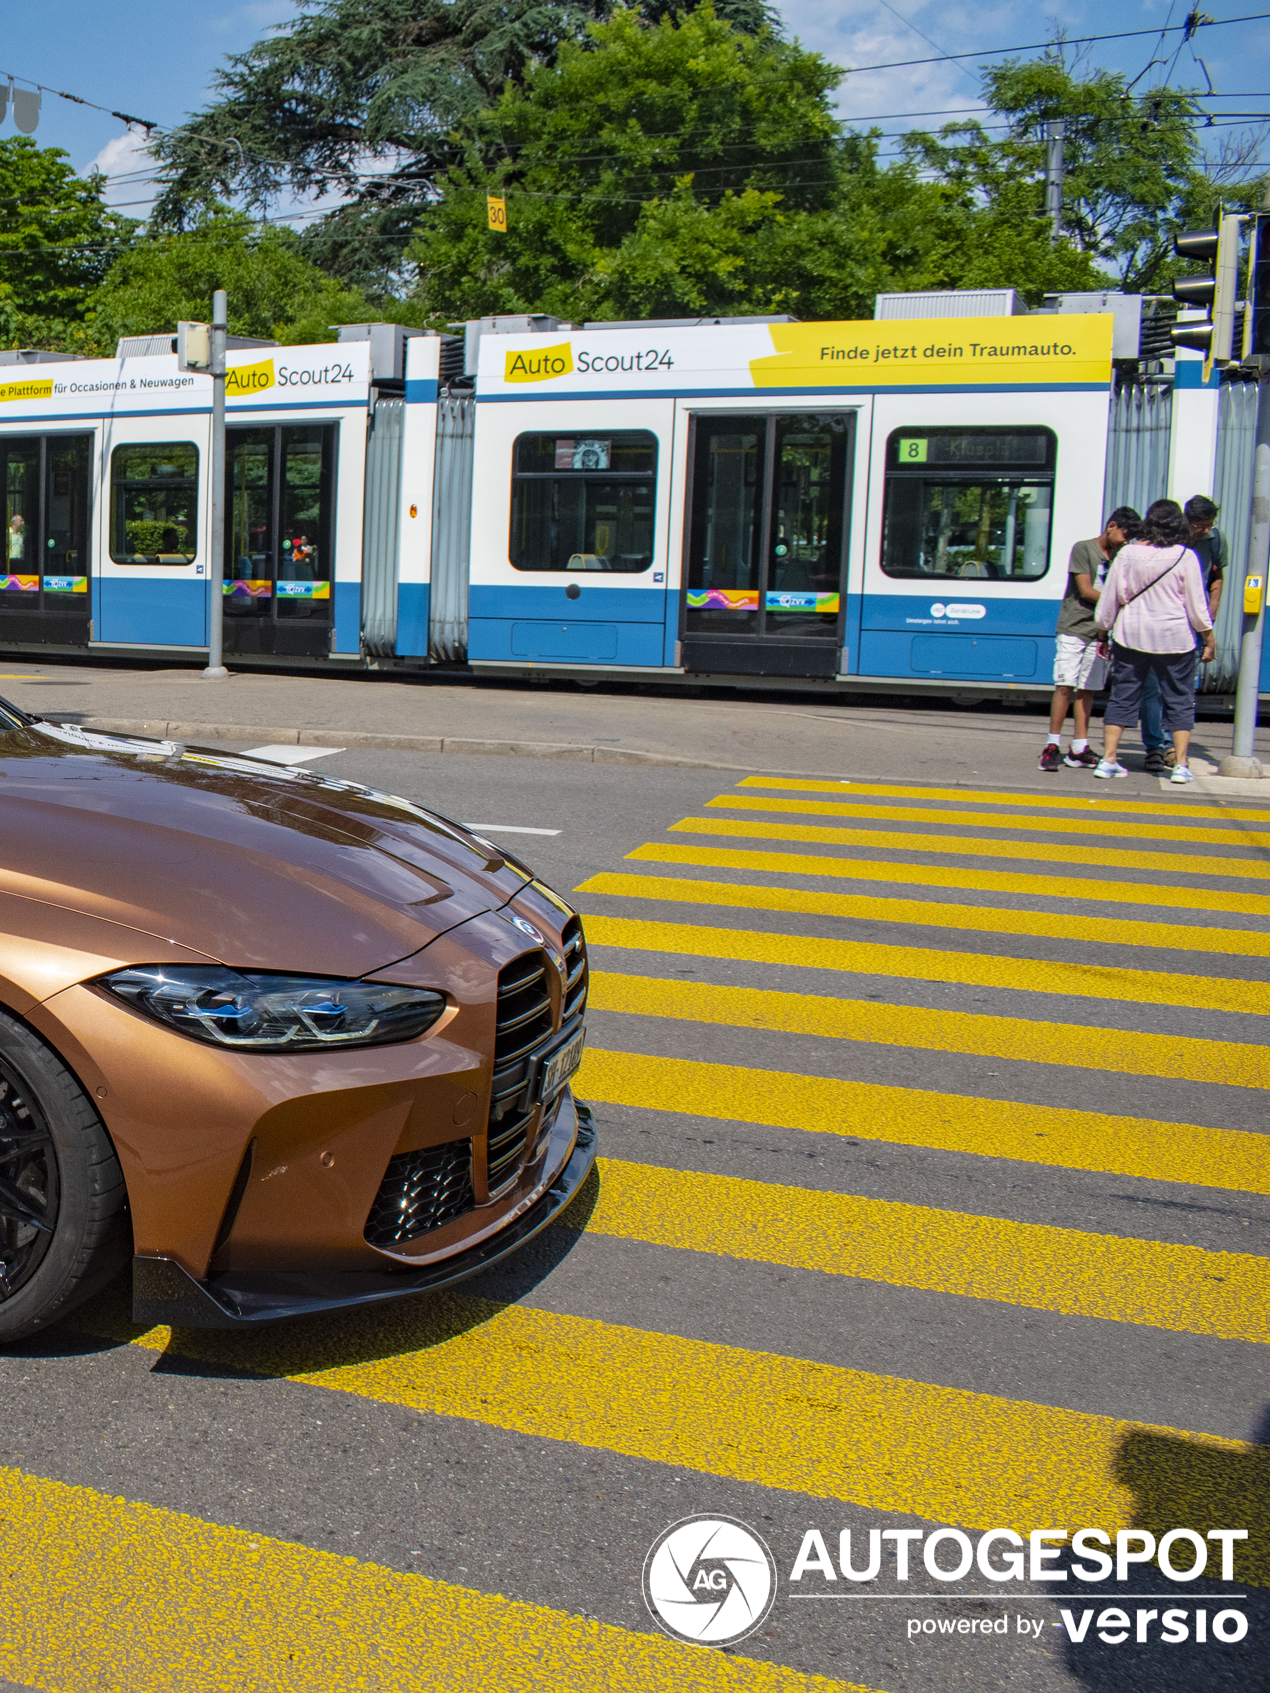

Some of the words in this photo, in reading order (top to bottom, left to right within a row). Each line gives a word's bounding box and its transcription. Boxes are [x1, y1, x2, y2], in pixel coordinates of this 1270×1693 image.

[490, 206, 505, 224] 30
[510, 354, 566, 375] Auto
[577, 349, 675, 373] Scout24
[820, 346, 870, 360] Finde
[874, 345, 917, 362] jetzt
[923, 343, 963, 358] dein
[969, 341, 1077, 357] Traumauto.
[8, 384, 52, 397] Plattform
[54, 384, 68, 394] für
[69, 381, 127, 393] Occasionen
[130, 379, 137, 389] &
[139, 376, 195, 390] Neuwagen
[225, 370, 269, 389] Auto
[277, 363, 354, 387] Scout24
[908, 442, 919, 458] 8
